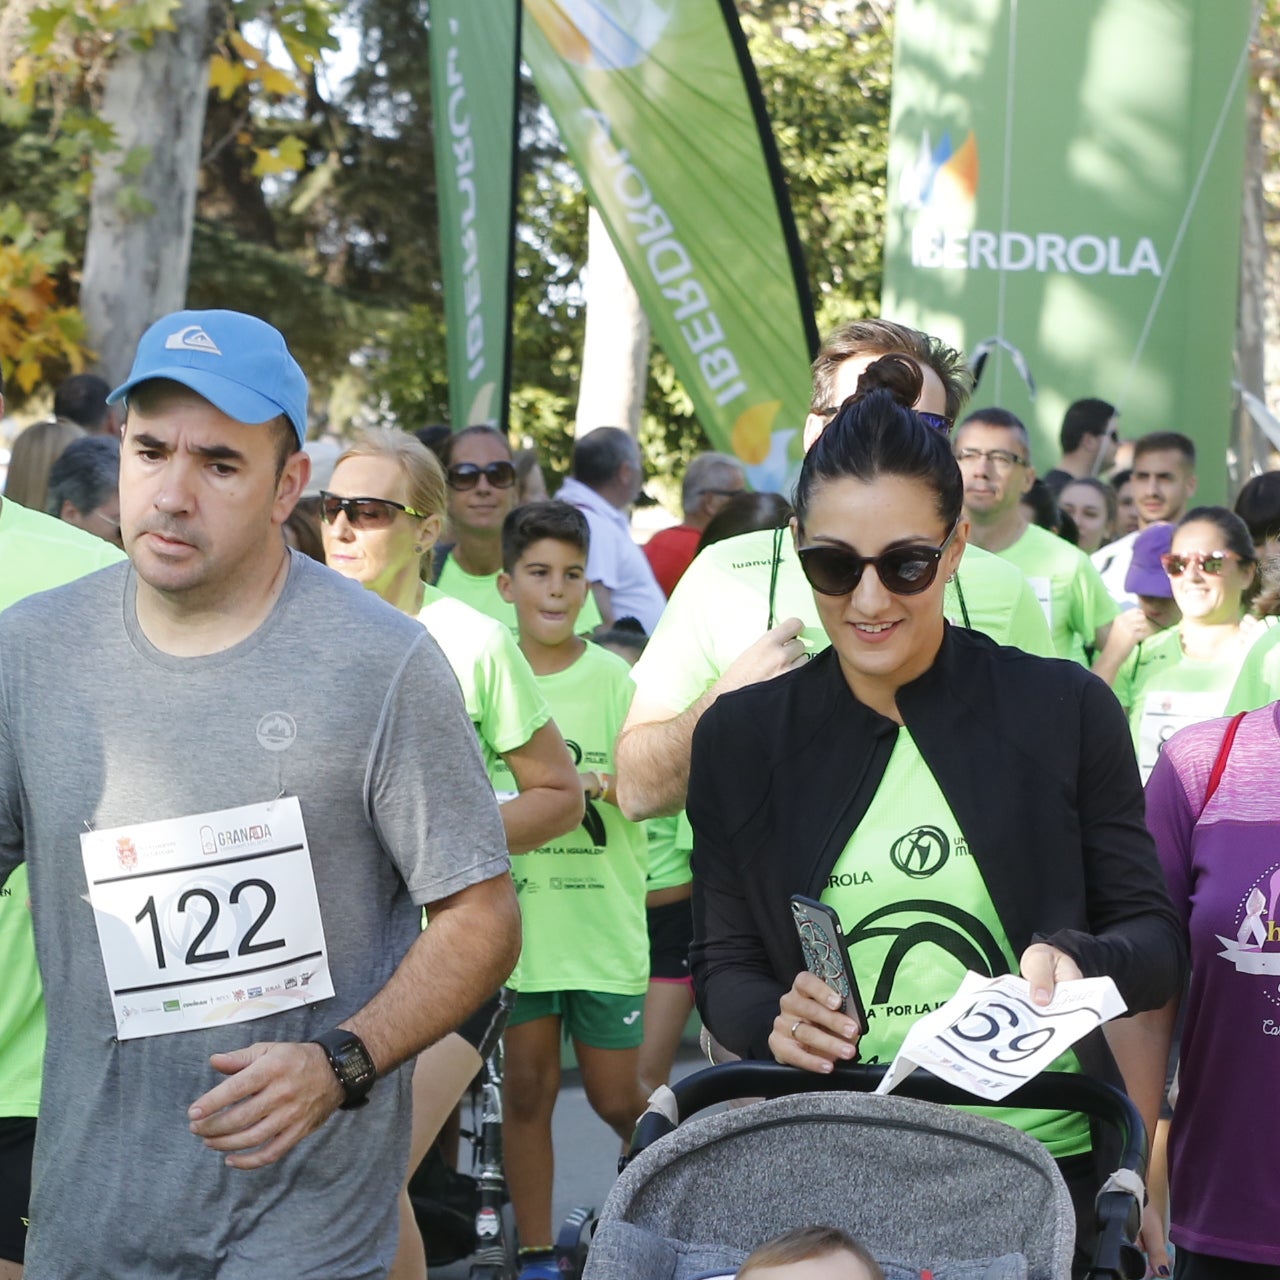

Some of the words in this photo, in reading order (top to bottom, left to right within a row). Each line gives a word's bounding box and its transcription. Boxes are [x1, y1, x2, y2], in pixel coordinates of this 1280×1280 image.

[911, 228, 1163, 277] IBERDROLA
[731, 558, 772, 569] luanvi
[136, 877, 286, 972] 122
[914, 1002, 932, 1014] LA
